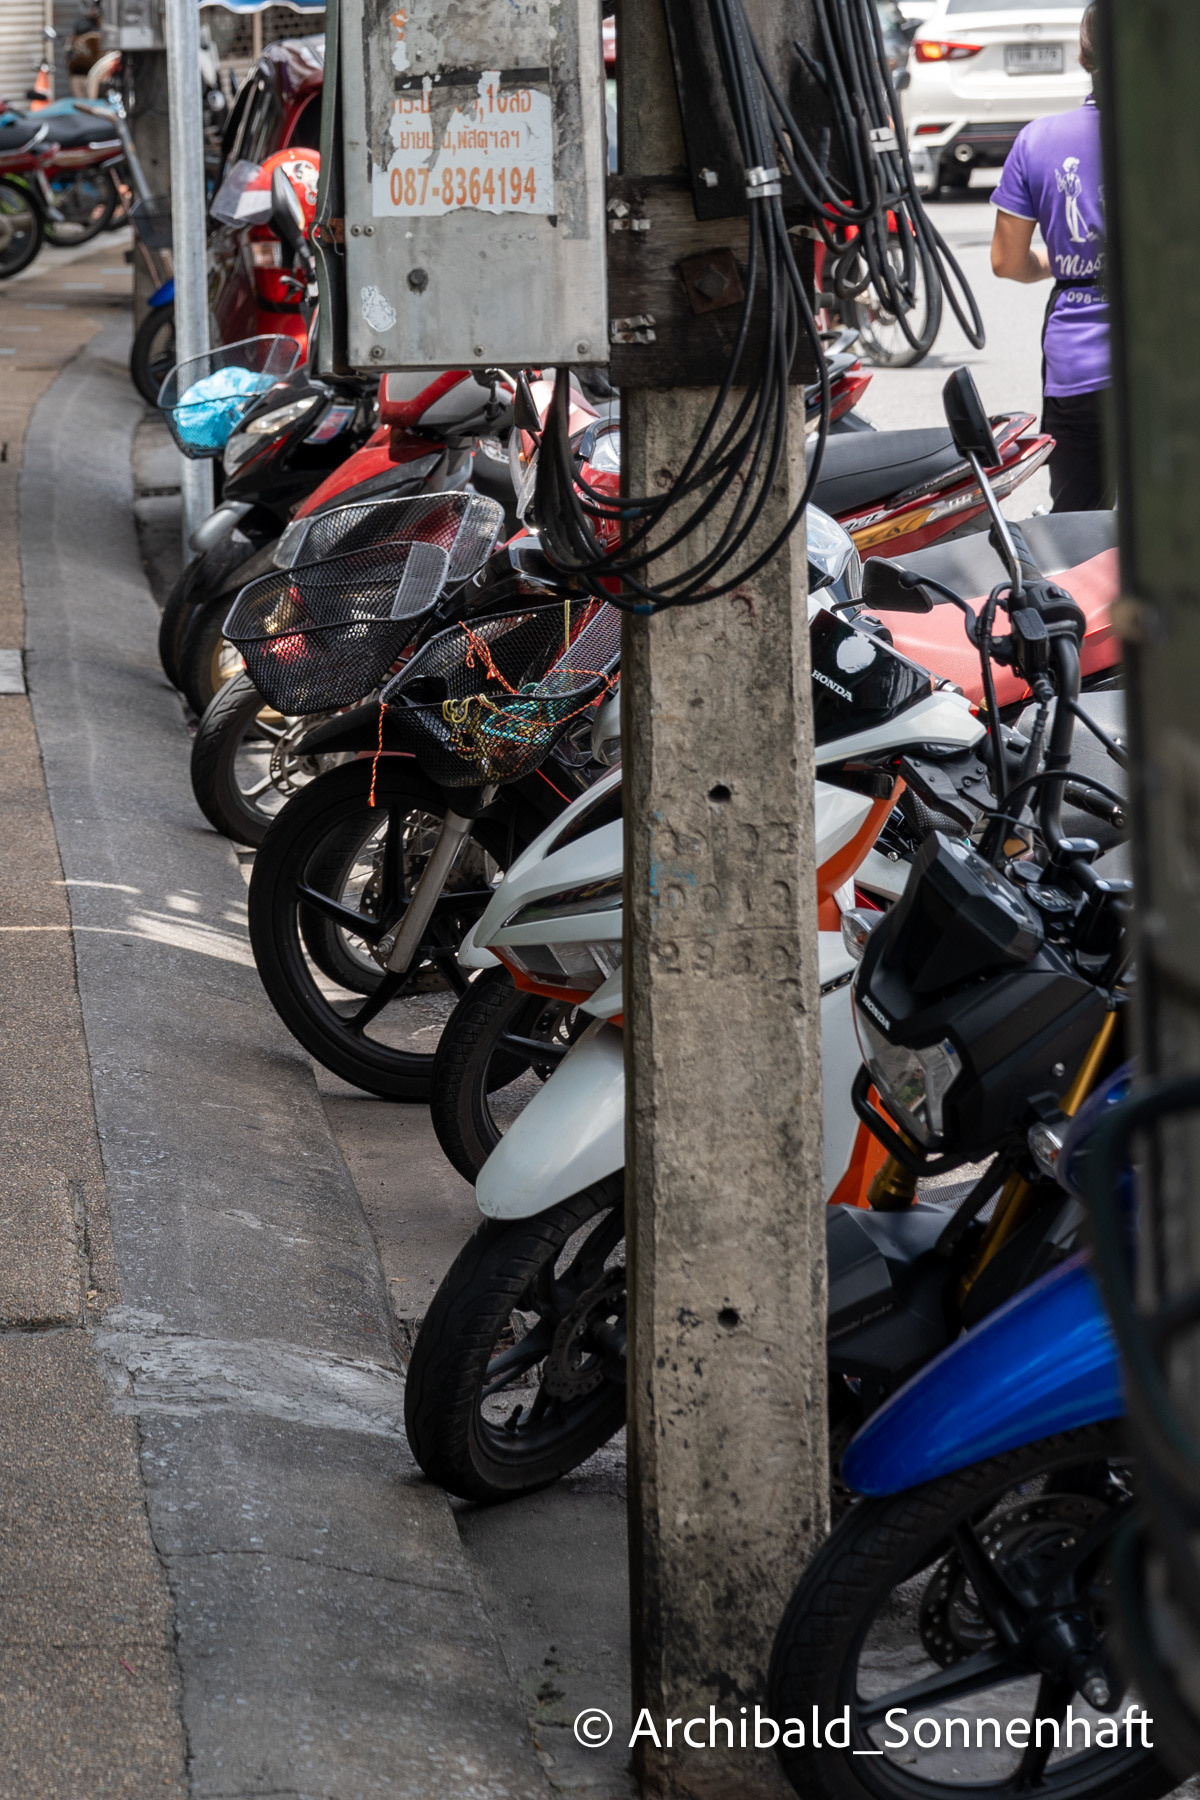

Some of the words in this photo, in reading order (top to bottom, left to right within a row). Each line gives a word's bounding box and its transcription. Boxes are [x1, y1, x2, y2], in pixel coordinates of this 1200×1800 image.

[390, 166, 537, 206] 087-8364194
[811, 668, 853, 702] HONDA
[862, 994, 890, 1031] HONDA
